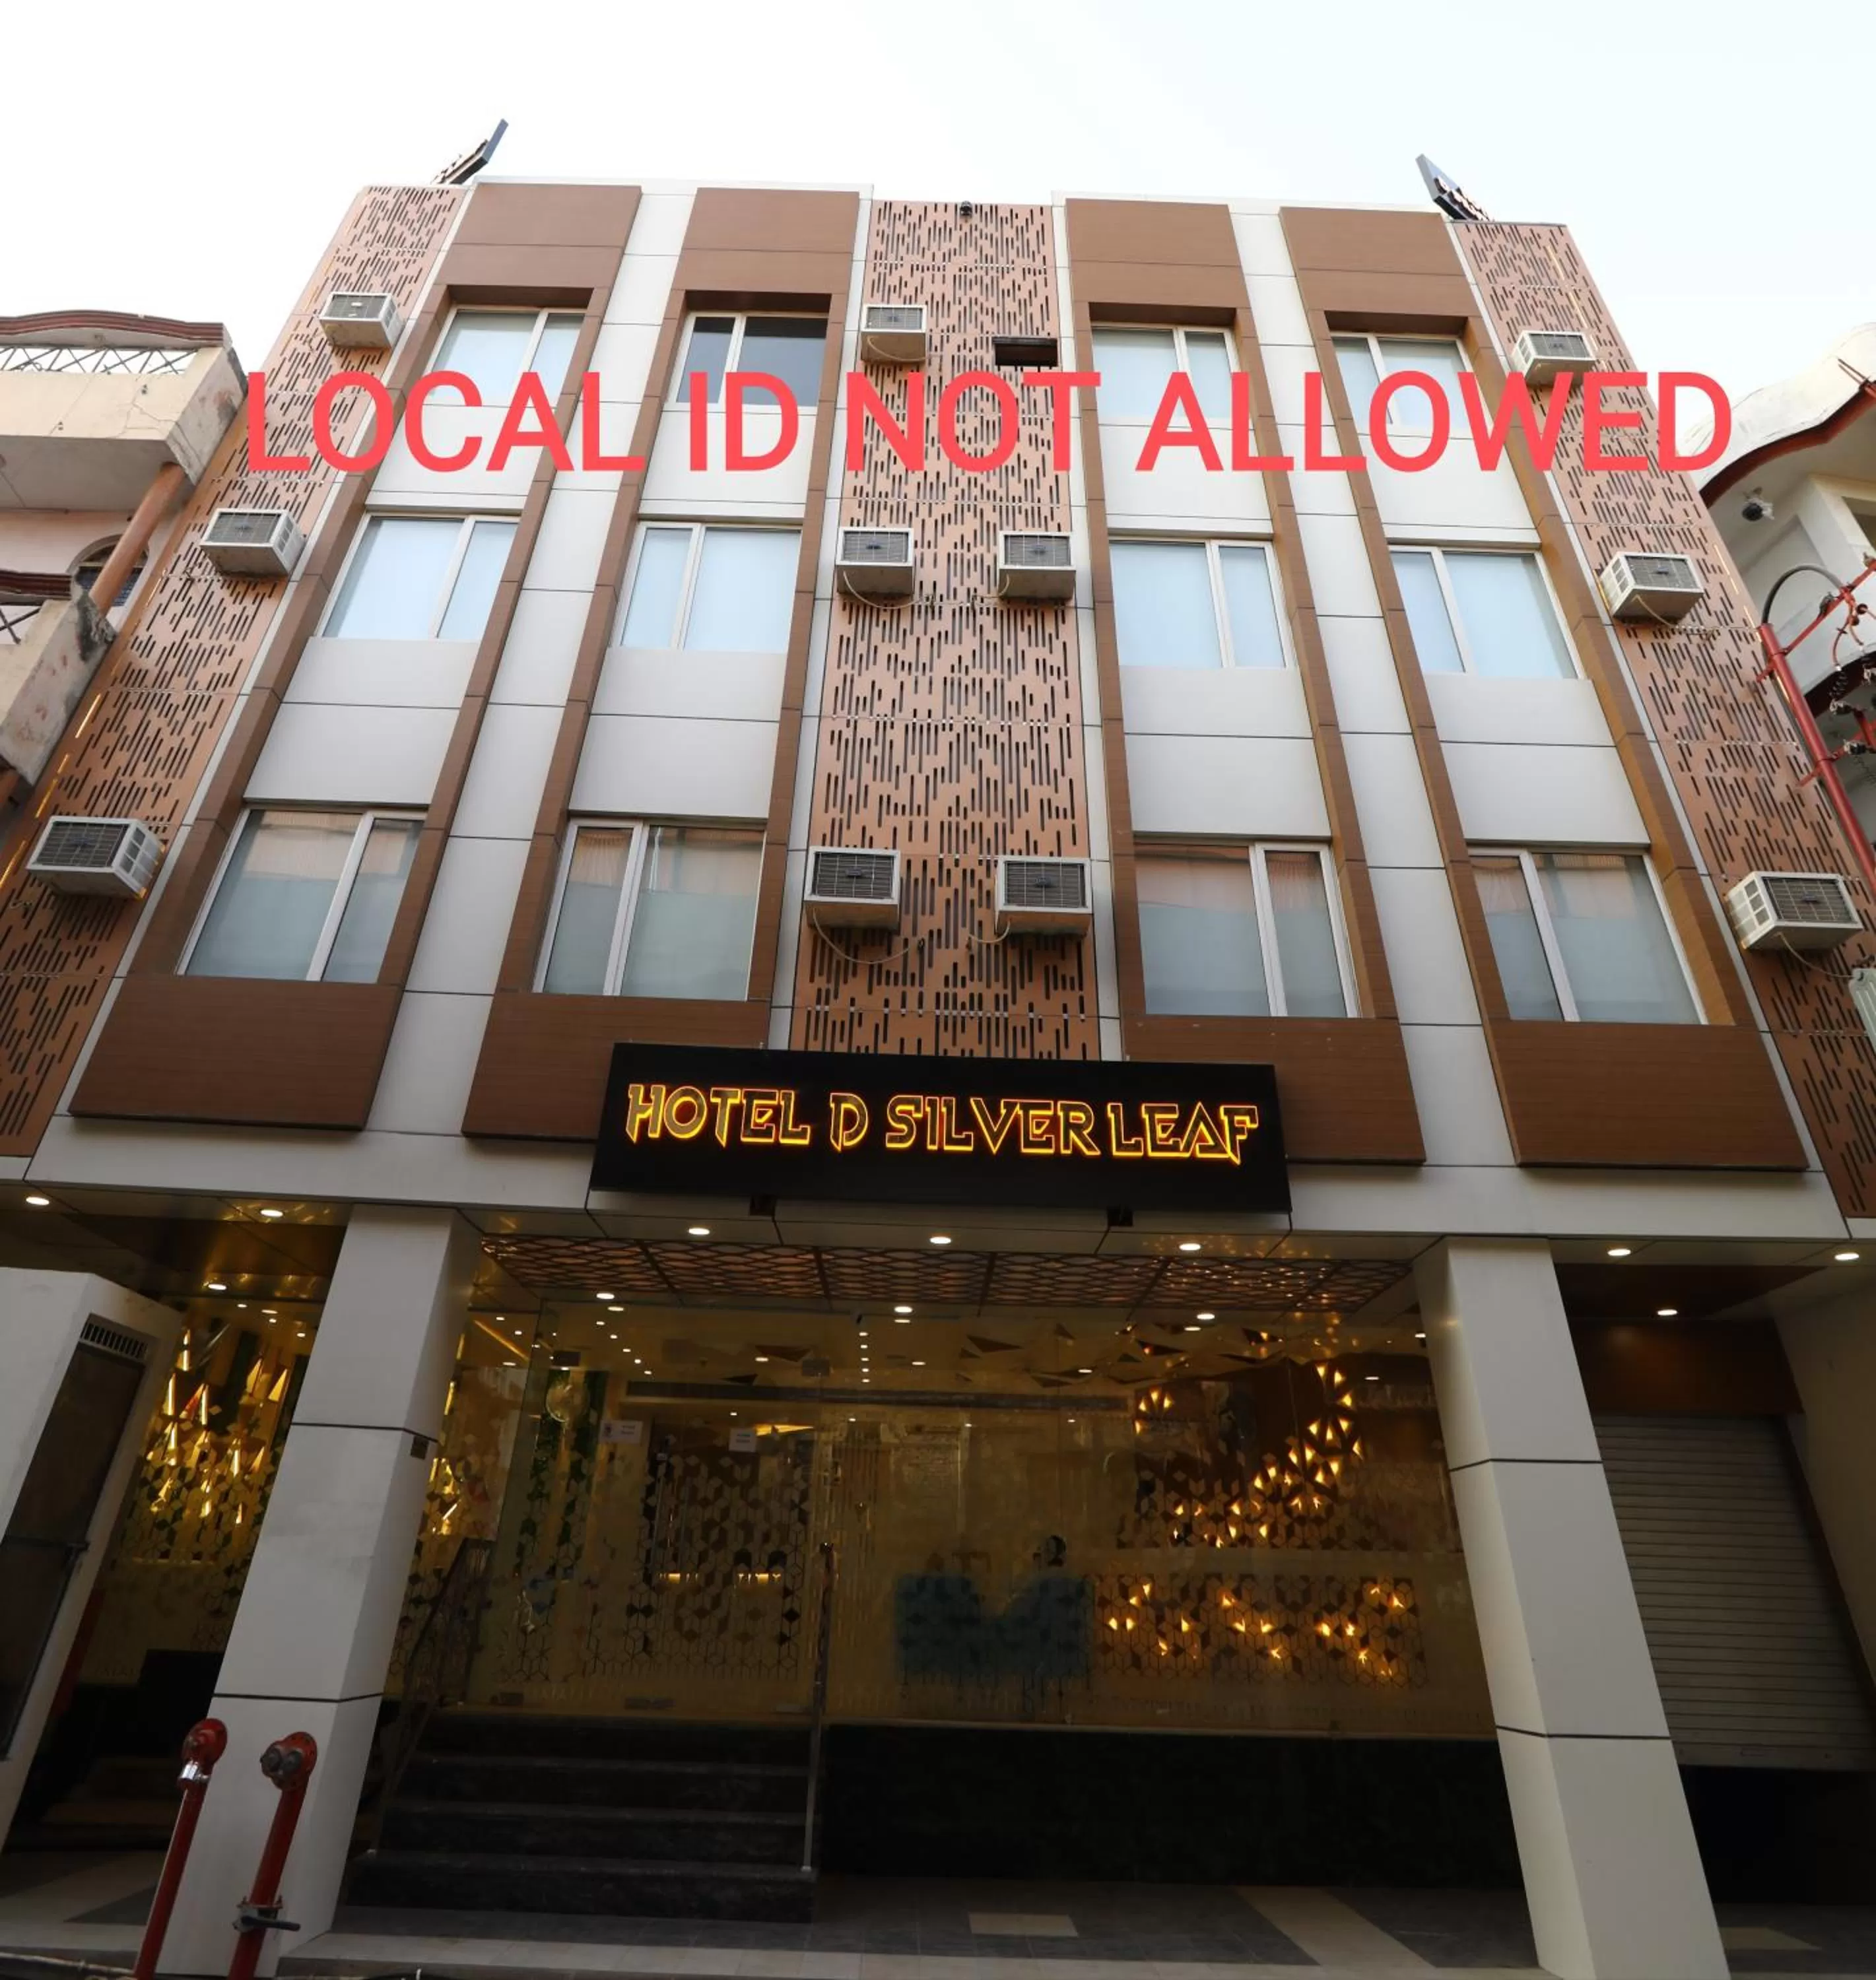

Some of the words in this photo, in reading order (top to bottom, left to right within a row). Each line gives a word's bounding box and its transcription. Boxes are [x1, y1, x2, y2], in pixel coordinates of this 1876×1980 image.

[625, 1083, 811, 1148] HOTEL
[830, 1091, 869, 1153] D
[885, 1094, 1101, 1156] SILVER
[1106, 1100, 1259, 1165] LEAF
